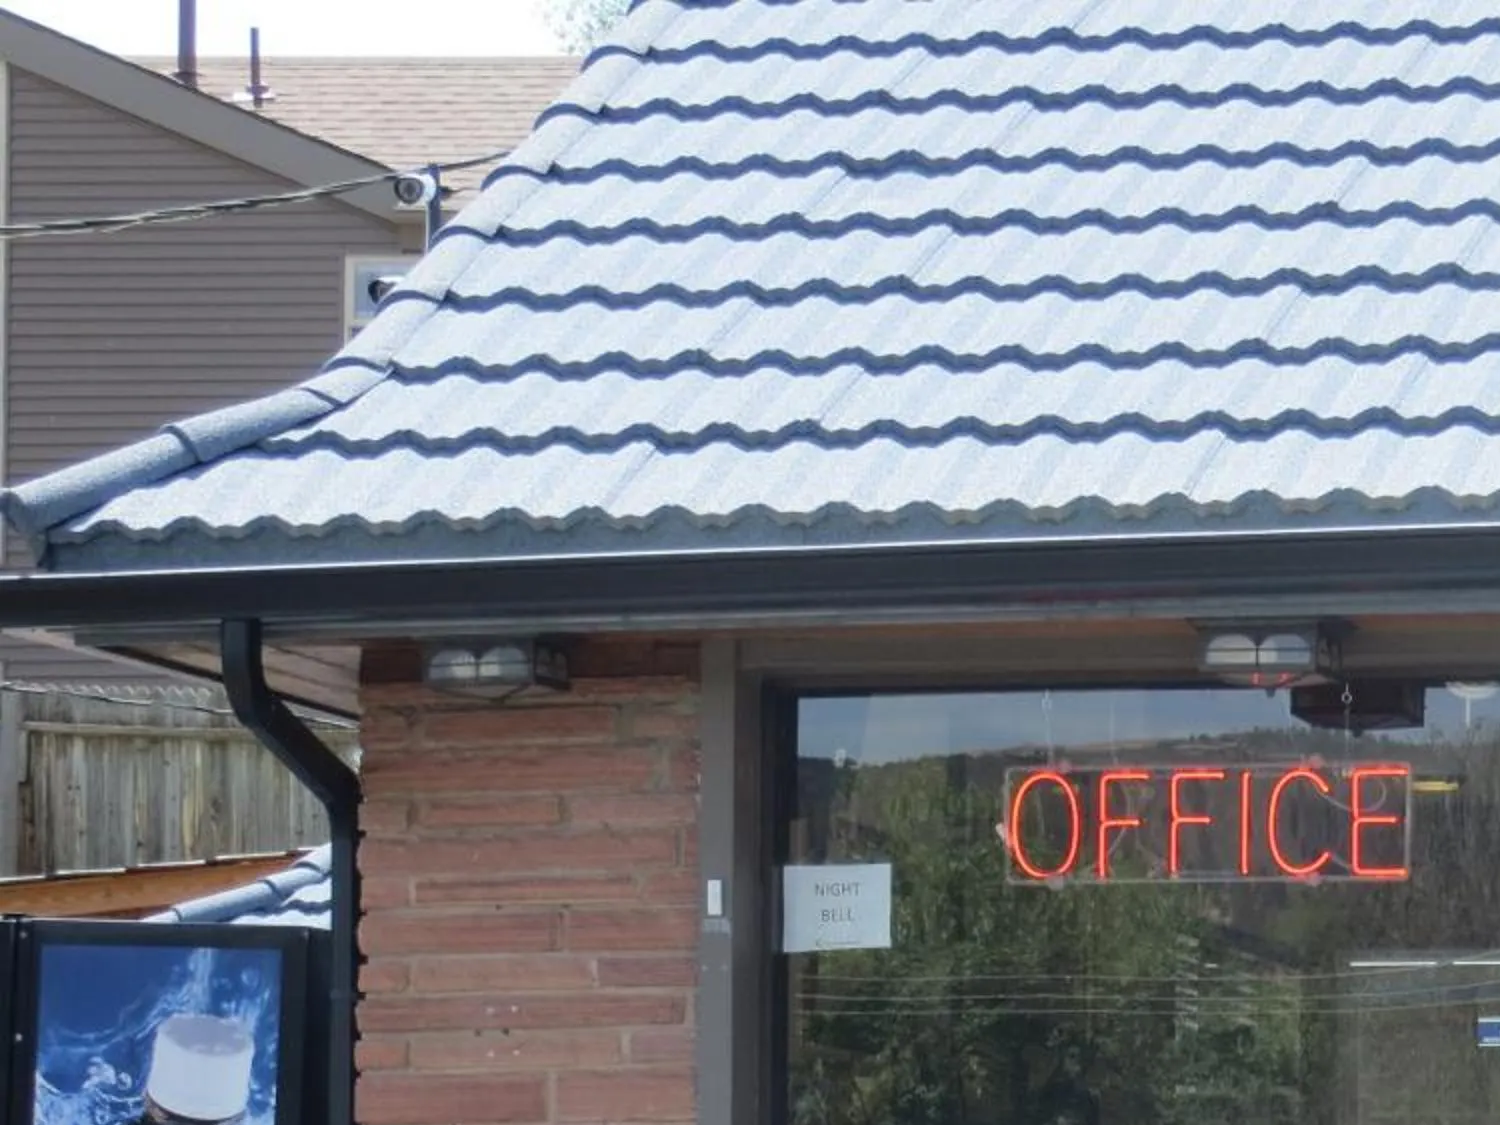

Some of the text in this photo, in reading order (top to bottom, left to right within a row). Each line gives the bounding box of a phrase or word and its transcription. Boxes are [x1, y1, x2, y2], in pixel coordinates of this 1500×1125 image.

[1011, 763, 1410, 880] OFFICE
[815, 882, 861, 897] NIGHT
[822, 908, 856, 922] BELL
